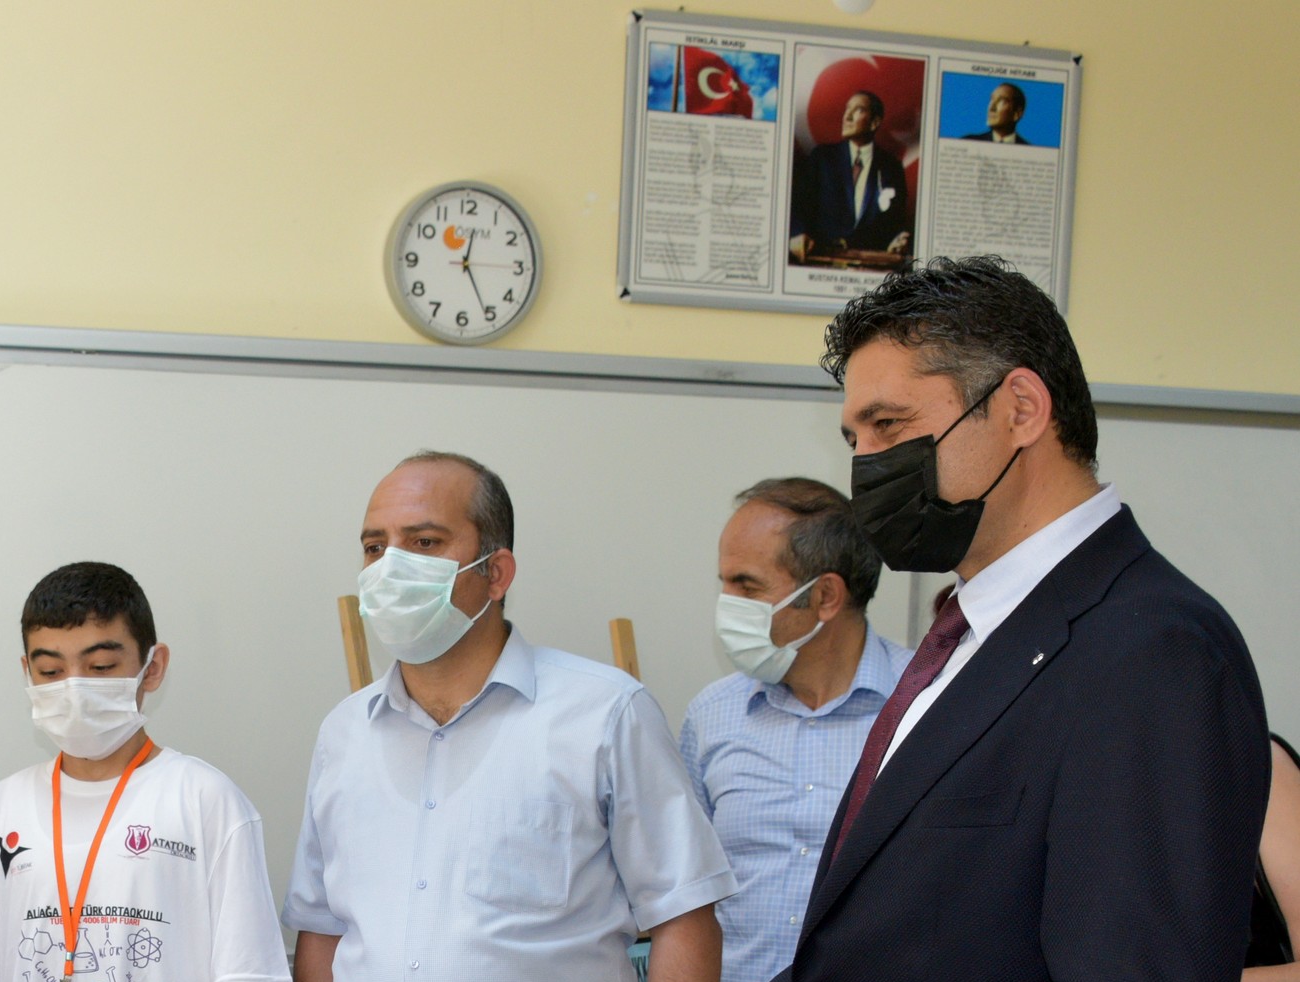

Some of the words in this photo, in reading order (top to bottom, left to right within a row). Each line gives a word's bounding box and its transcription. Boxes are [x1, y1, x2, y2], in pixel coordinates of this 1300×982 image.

[436, 205, 448, 221] 11
[461, 199, 478, 216] 12
[493, 210, 498, 226] 1
[417, 223, 436, 239] 10
[506, 231, 517, 247] 2
[405, 252, 419, 268] 9
[513, 260, 524, 276] 3
[411, 281, 425, 297] 8
[502, 288, 514, 304] 4
[428, 301, 442, 318] 7
[484, 306, 497, 322] 5
[455, 311, 469, 327] 6
[151, 838, 197, 855] ATATÜRK
[26, 906, 59, 920] ALİAĞA
[105, 906, 163, 922] ORTAOKULU
[83, 916, 100, 924] 4006
[120, 917, 140, 926] FUARI
